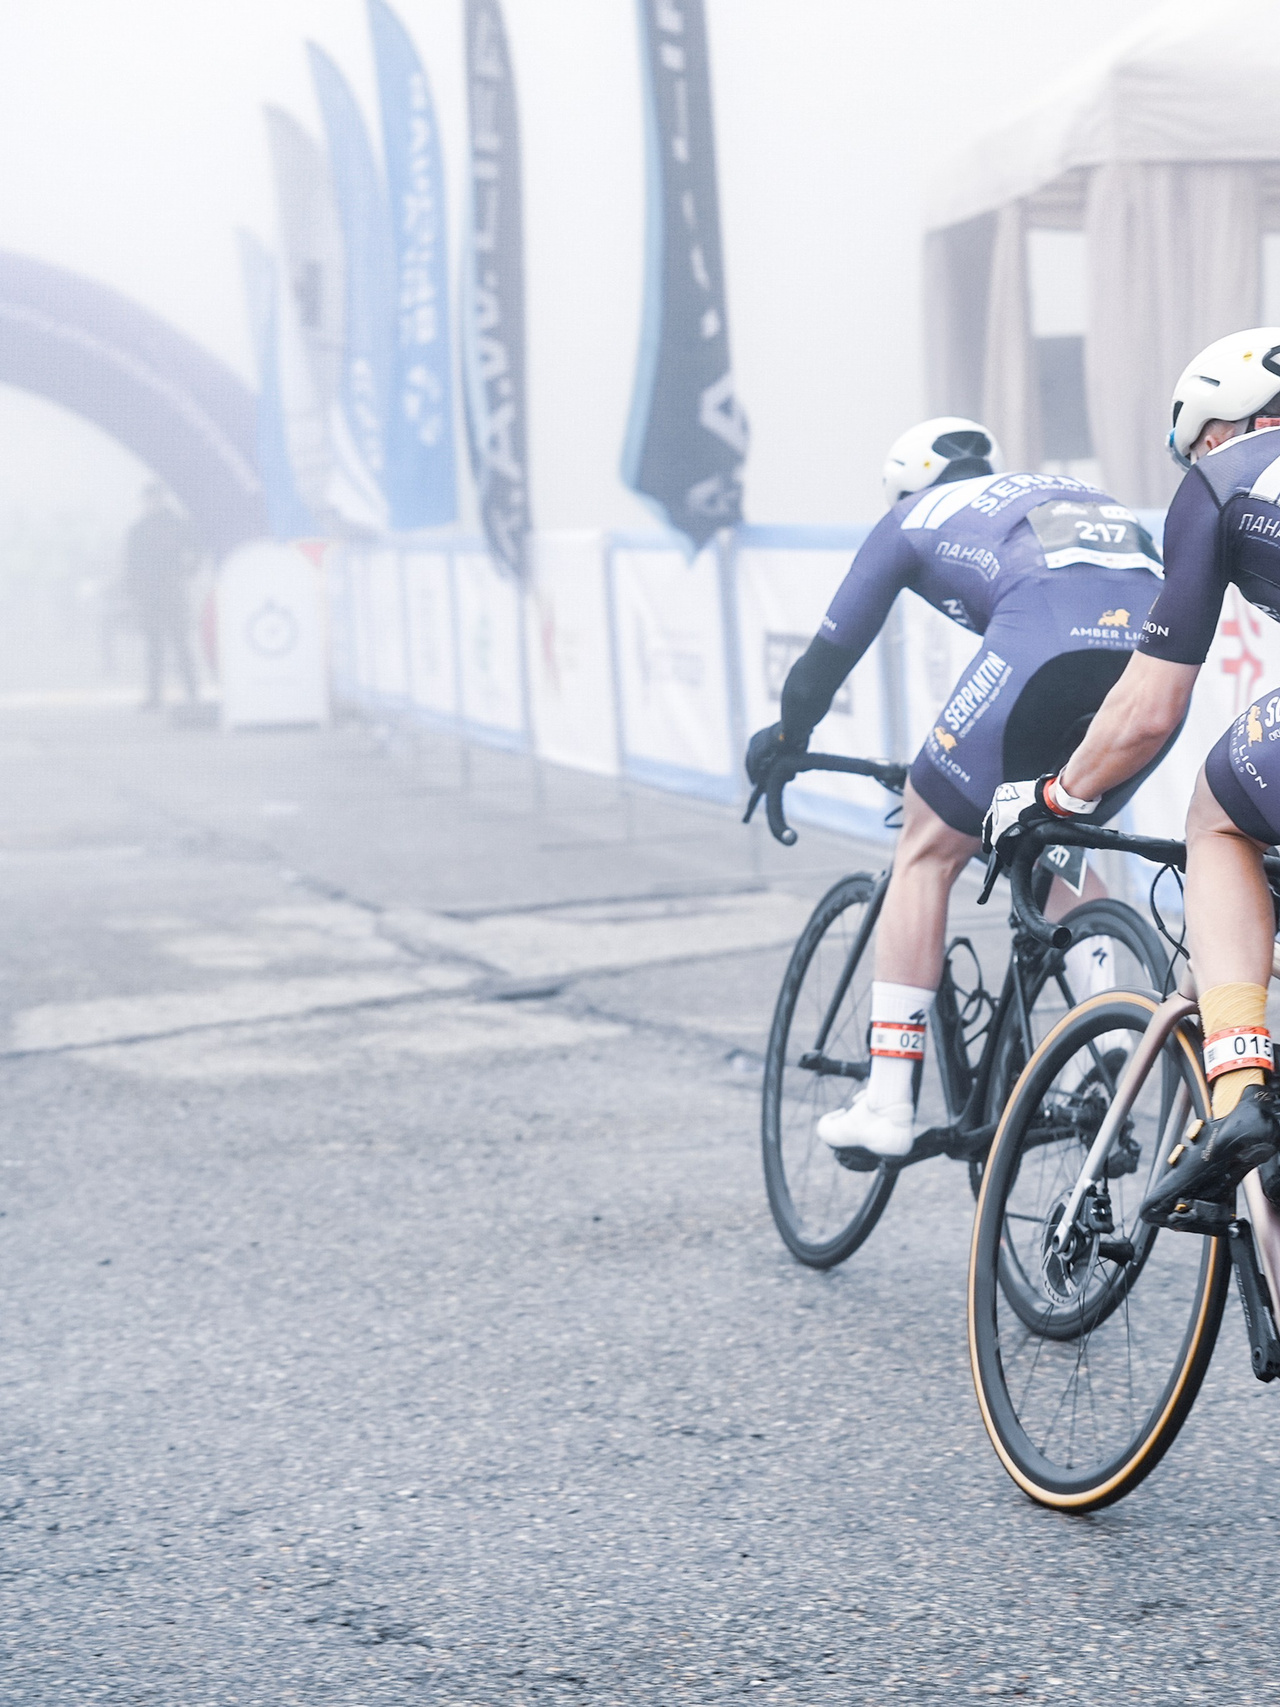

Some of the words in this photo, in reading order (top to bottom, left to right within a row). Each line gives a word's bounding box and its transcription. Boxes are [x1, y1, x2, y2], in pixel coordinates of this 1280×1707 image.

[1074, 520, 1127, 543] 217
[1070, 627, 1120, 639] AMBER
[944, 650, 1007, 731] SERPANTIN
[1239, 745, 1267, 789] LION
